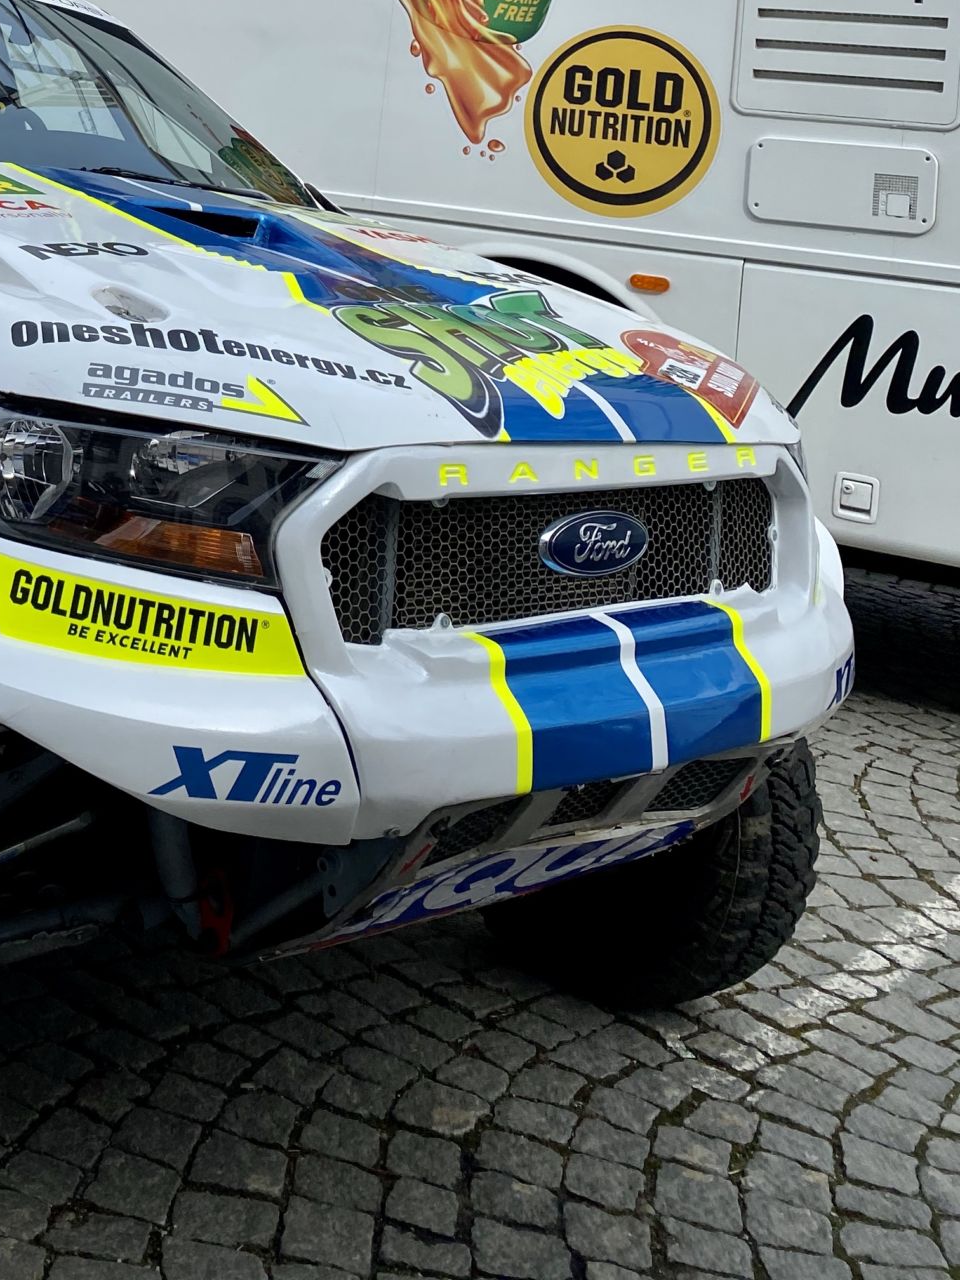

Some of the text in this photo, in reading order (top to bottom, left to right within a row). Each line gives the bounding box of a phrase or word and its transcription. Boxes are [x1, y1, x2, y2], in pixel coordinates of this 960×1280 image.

[493, 3, 537, 23] FREE
[562, 63, 686, 114] GOLD
[549, 110, 692, 149] NUTRITION
[18, 241, 150, 261] NEXO
[10, 319, 413, 391] oneshotenergy.cz
[87, 361, 246, 399] agados
[87, 385, 212, 412] TRAILERS
[439, 446, 757, 487] RANGER
[573, 521, 633, 564] Ford
[8, 567, 259, 654] GOLDNUTRITION
[67, 622, 193, 660] BE EXCELLENT
[148, 744, 342, 807] XTline
